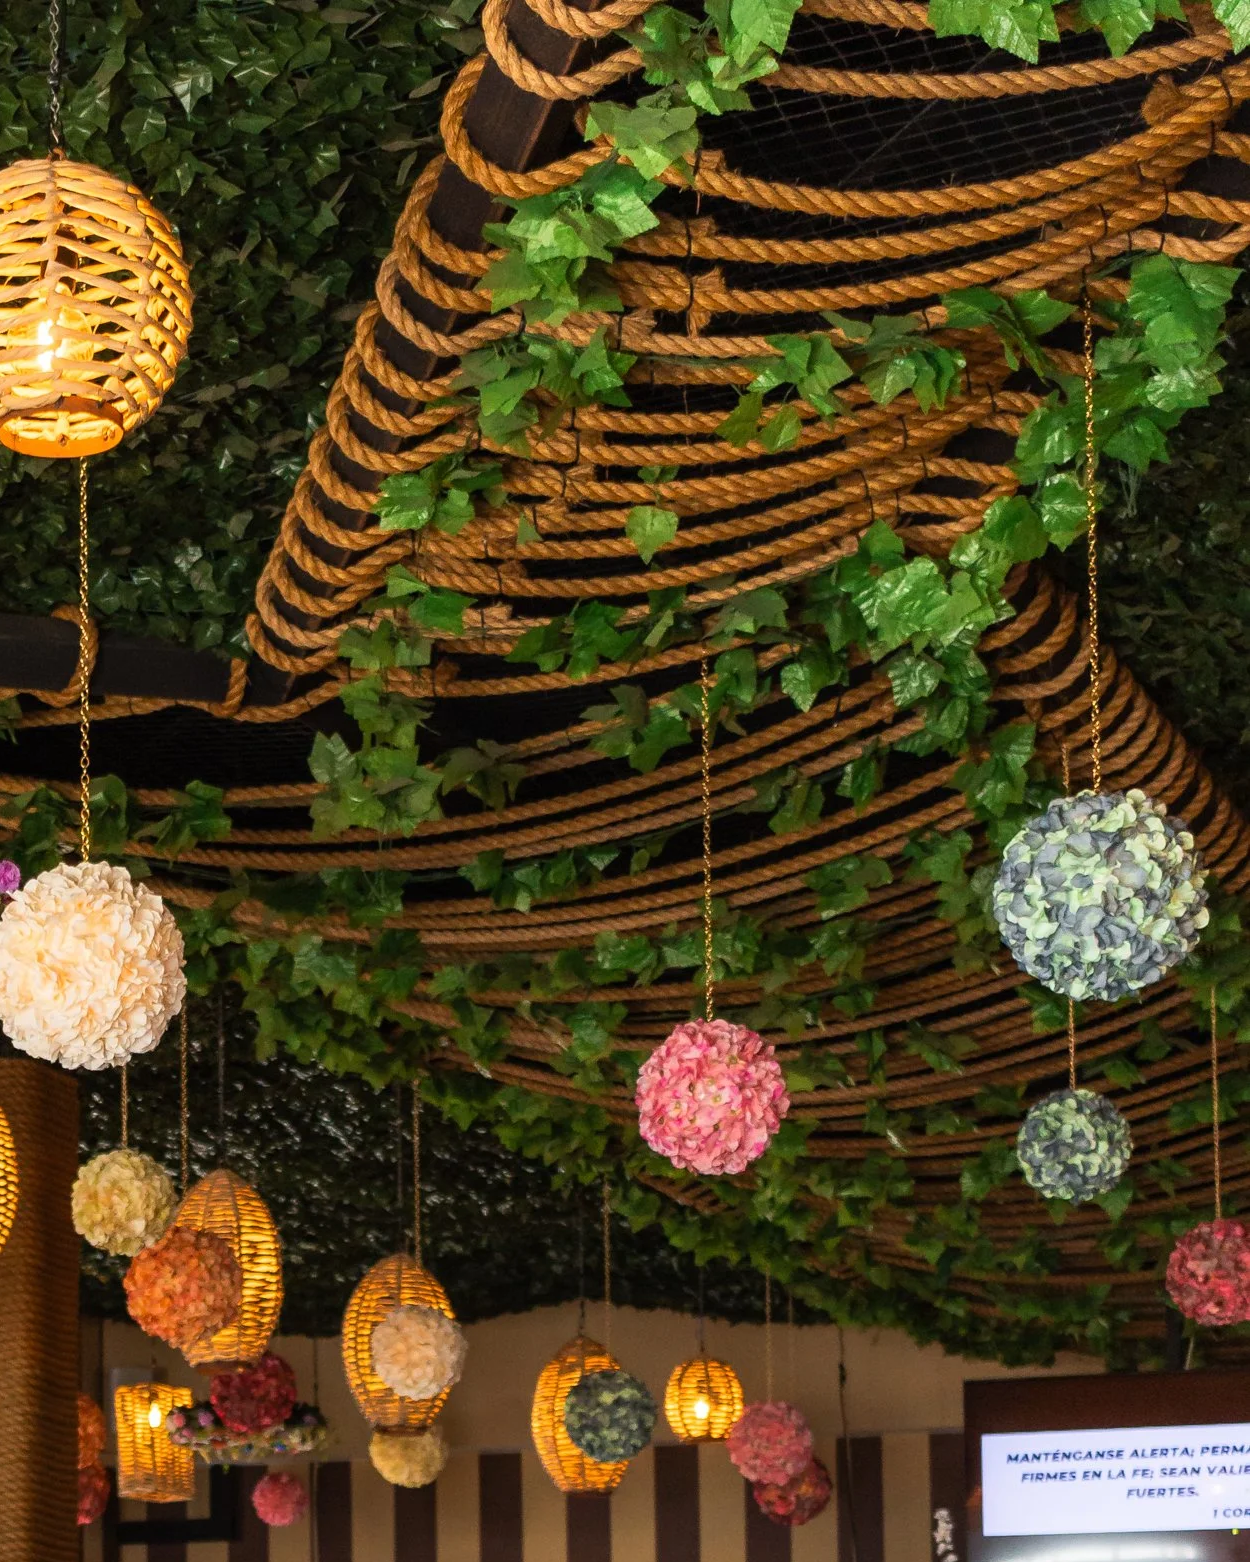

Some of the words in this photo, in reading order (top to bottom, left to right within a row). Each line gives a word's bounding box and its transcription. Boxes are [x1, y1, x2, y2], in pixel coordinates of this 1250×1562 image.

[1006, 1449, 1125, 1464] MANTÉNGANSE
[1129, 1447, 1195, 1459] ALERTA;
[1021, 1471, 1077, 1483] FIRMES
[1082, 1470, 1103, 1481] EN
[1108, 1469, 1126, 1480] LA
[1159, 1466, 1202, 1477] SEAN
[1126, 1486, 1200, 1498] FUERTES.
